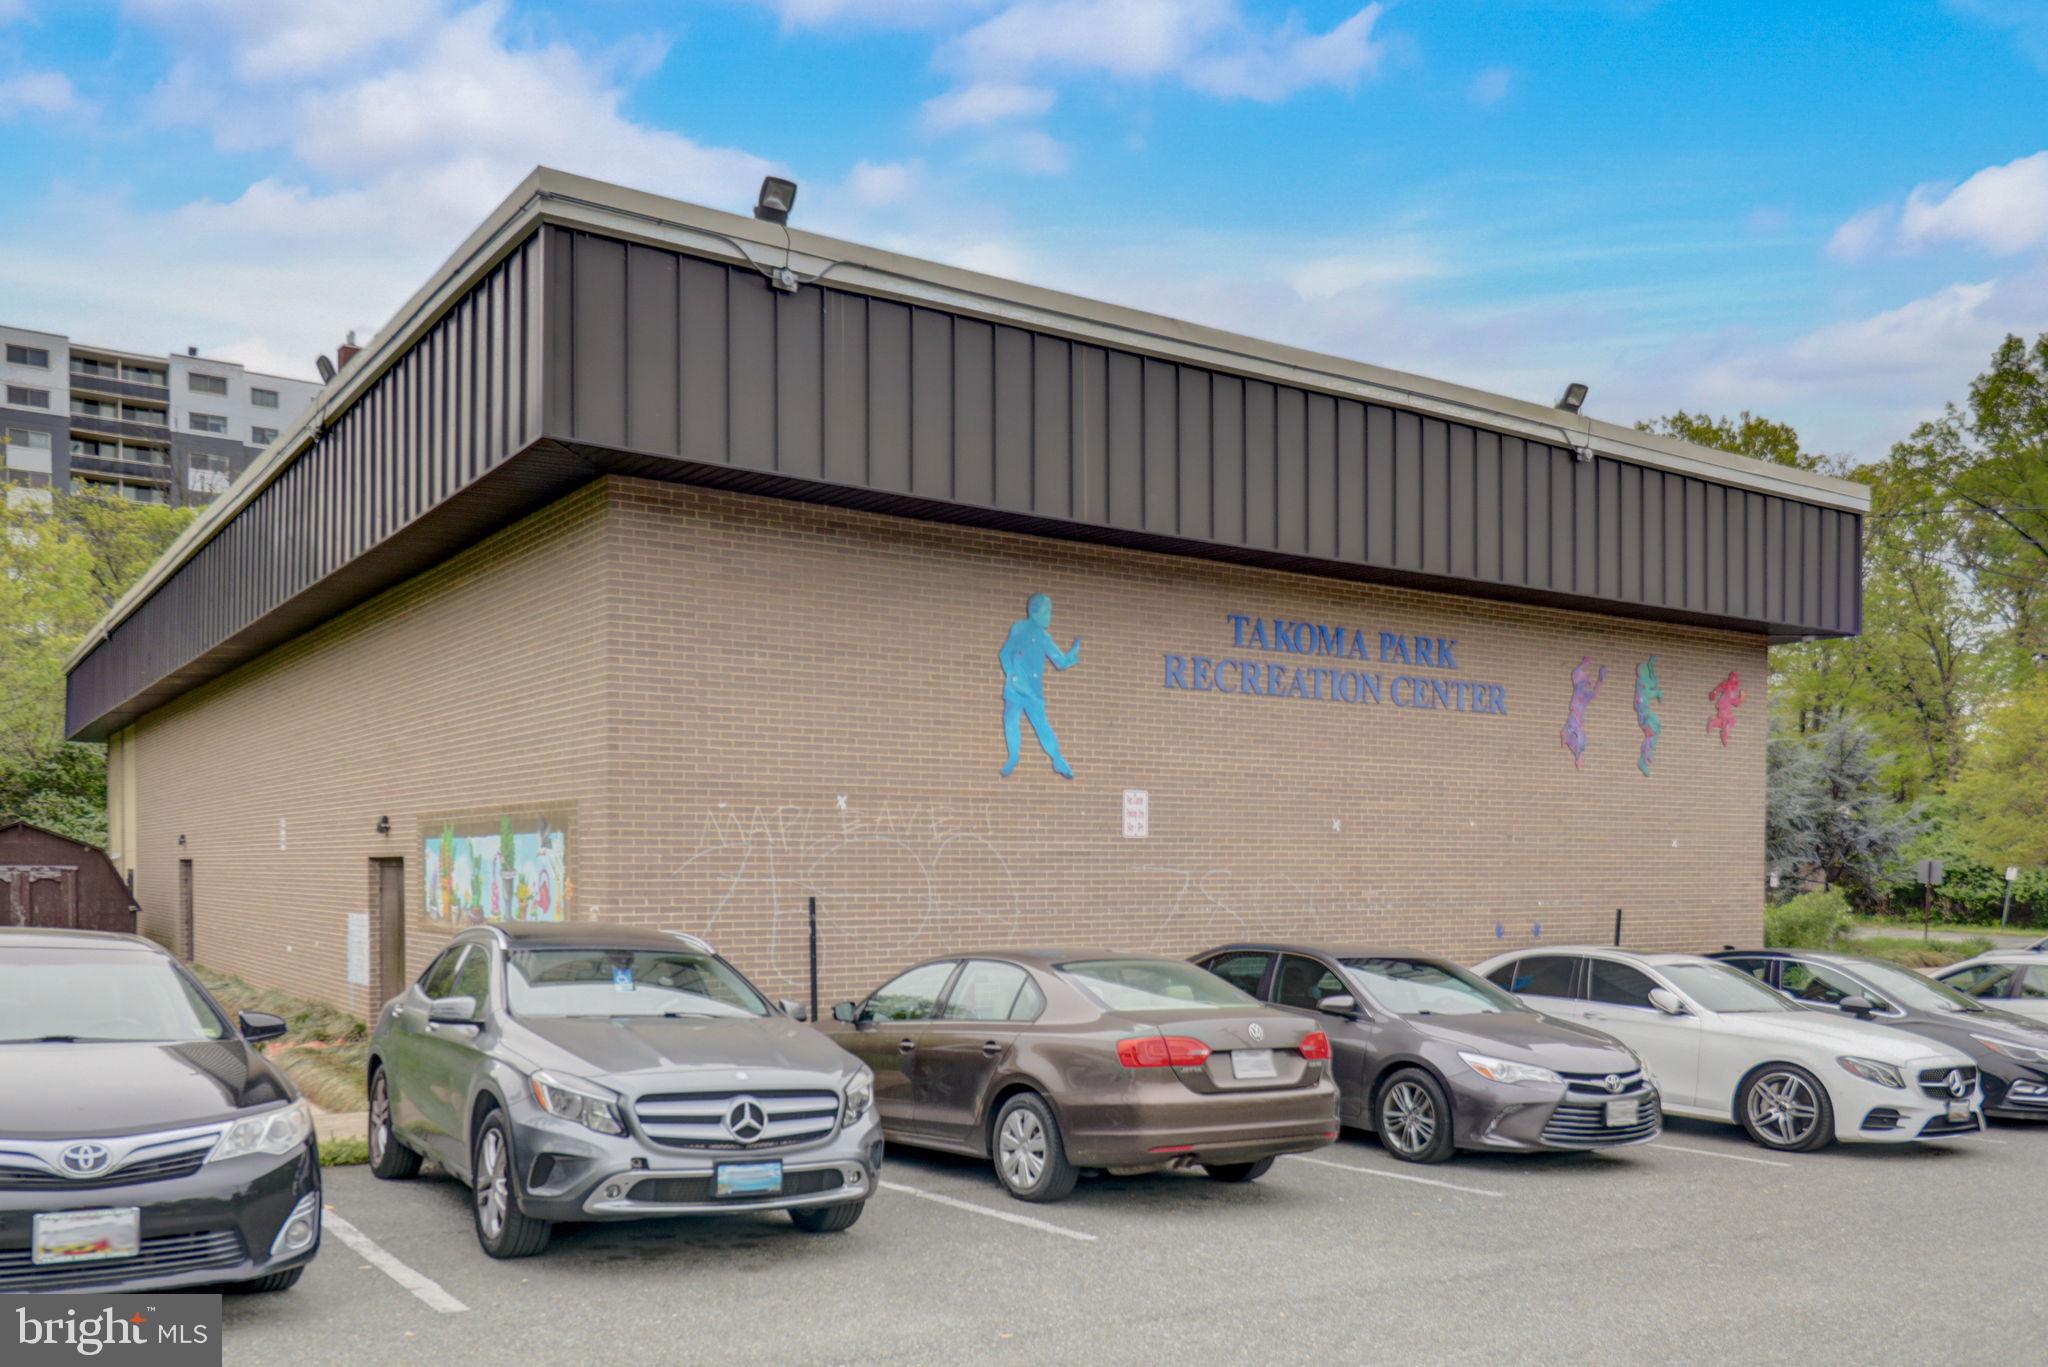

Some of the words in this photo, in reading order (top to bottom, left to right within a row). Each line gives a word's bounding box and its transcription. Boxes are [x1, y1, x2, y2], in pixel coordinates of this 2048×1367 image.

[1227, 614, 1369, 660] TAKOMA
[1378, 631, 1458, 669] PARK
[1163, 654, 1382, 704] RECREATION
[1390, 675, 1508, 715] CENTER
